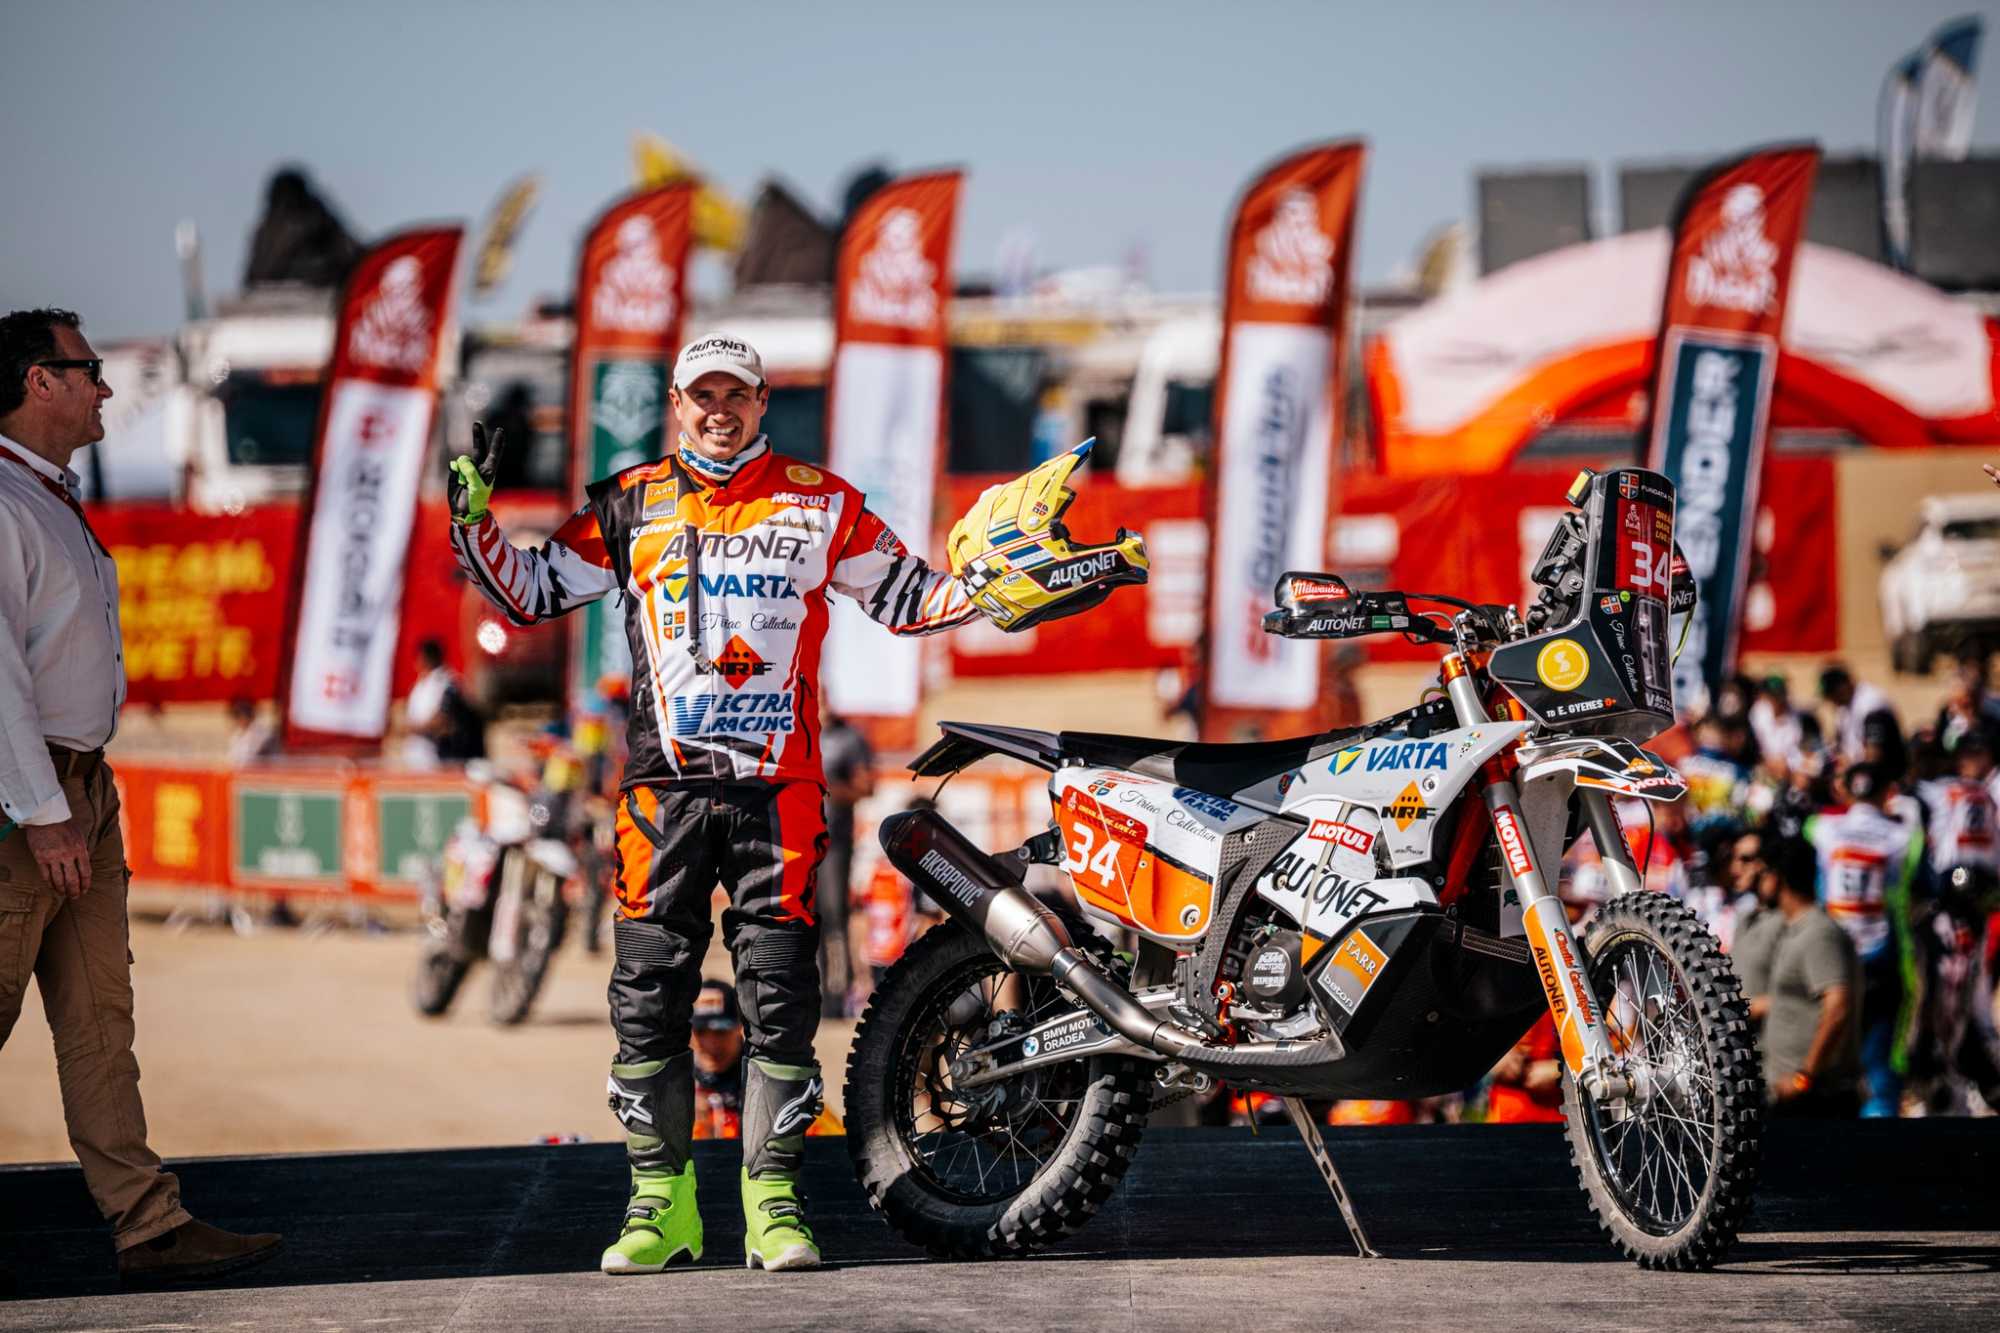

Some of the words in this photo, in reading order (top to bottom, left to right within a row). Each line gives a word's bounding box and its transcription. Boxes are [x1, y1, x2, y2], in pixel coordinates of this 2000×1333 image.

[687, 340, 747, 355] AUTONET
[771, 492, 827, 508] MOTUL
[1668, 350, 1742, 715] DEENDER
[1047, 552, 1118, 587] AUTONET
[1630, 541, 1669, 596] 34
[698, 574, 800, 600] VARTA
[1293, 580, 1345, 598] Milwaukee
[750, 612, 797, 631] Collection
[1306, 615, 1366, 633] AUTONET
[706, 716, 793, 733] RACING
[1366, 743, 1448, 771] VARTA
[1120, 790, 1160, 815] Tiriac
[1167, 808, 1216, 842] Collection
[1186, 799, 1232, 822] RACING
[1381, 806, 1436, 819] NRF
[1311, 824, 1369, 850] MOTUL
[1494, 810, 1529, 873] MOTUL
[1060, 822, 1121, 888] 34
[1263, 851, 1388, 918] AUTONET
[1344, 937, 1377, 976] TARR
[1534, 946, 1567, 1014] AUTONET
[1043, 1025, 1068, 1041] BMW
[1044, 1031, 1087, 1051] ORADEA
